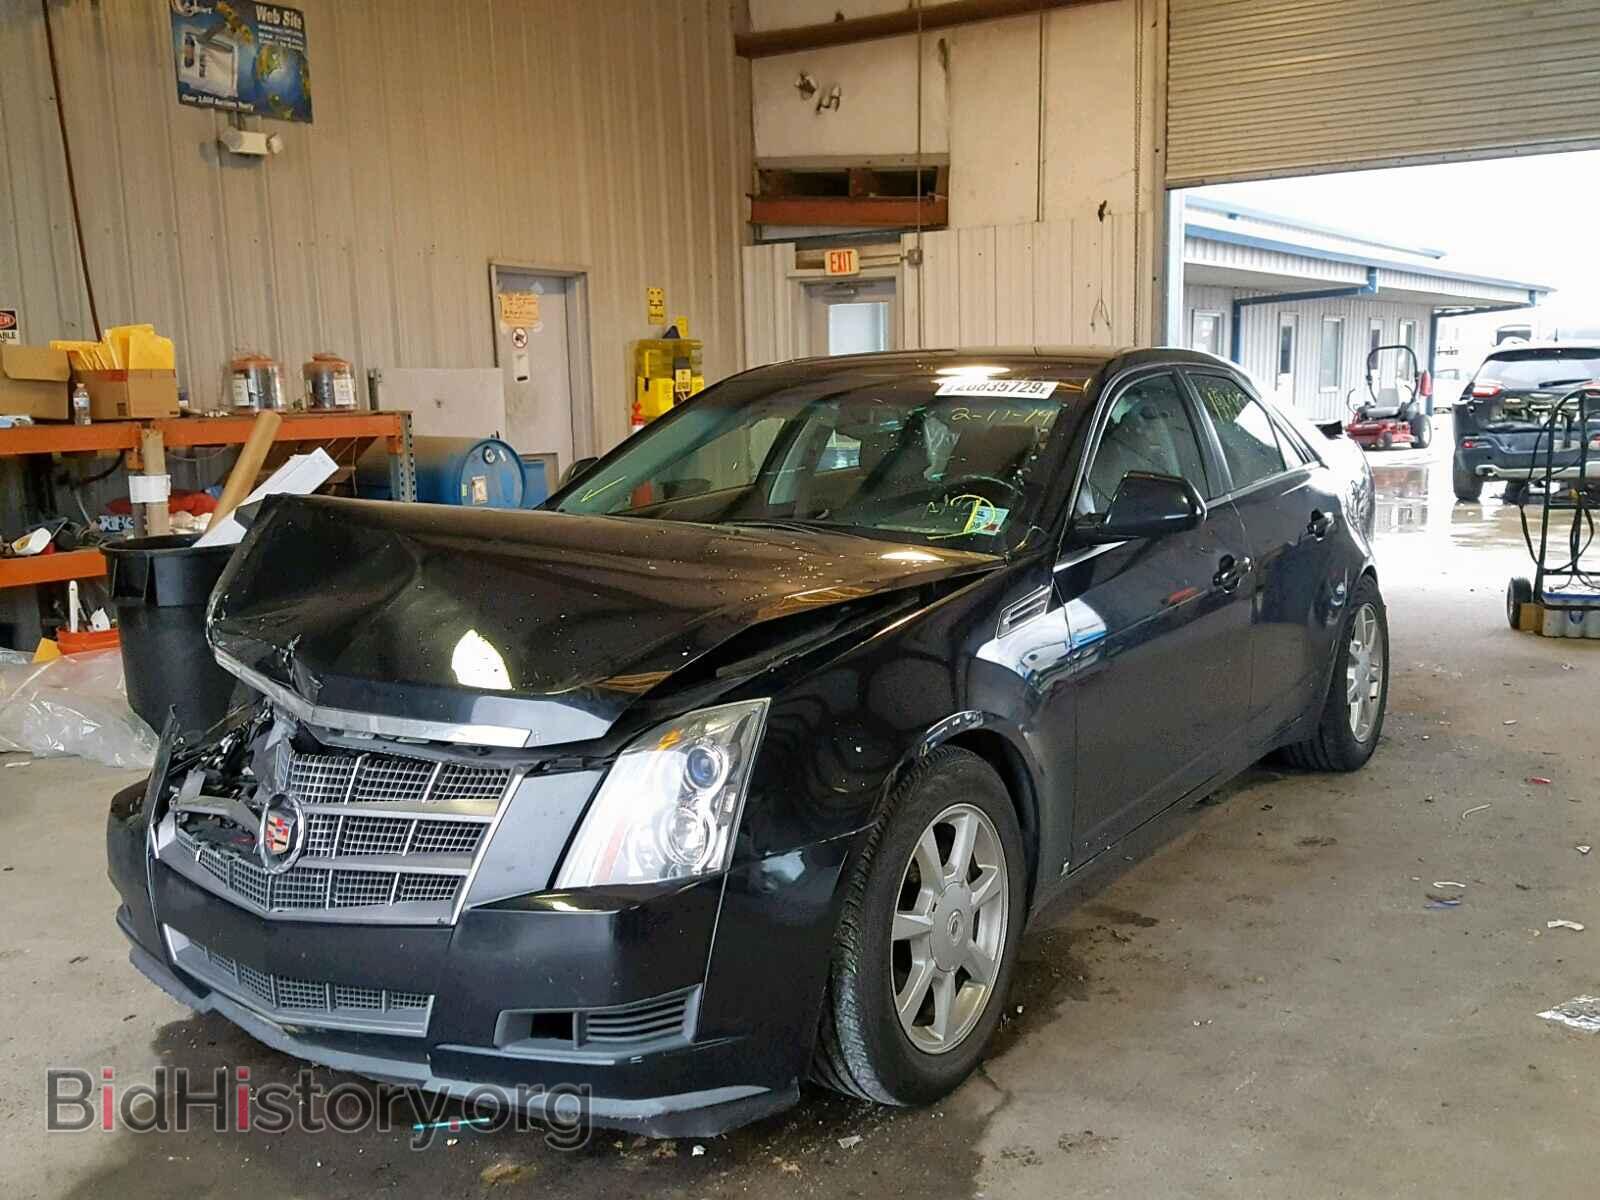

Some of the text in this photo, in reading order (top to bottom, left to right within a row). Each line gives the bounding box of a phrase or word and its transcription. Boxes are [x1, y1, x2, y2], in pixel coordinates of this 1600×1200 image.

[256, 5, 303, 30] Web Site
[830, 251, 852, 273] EXIT
